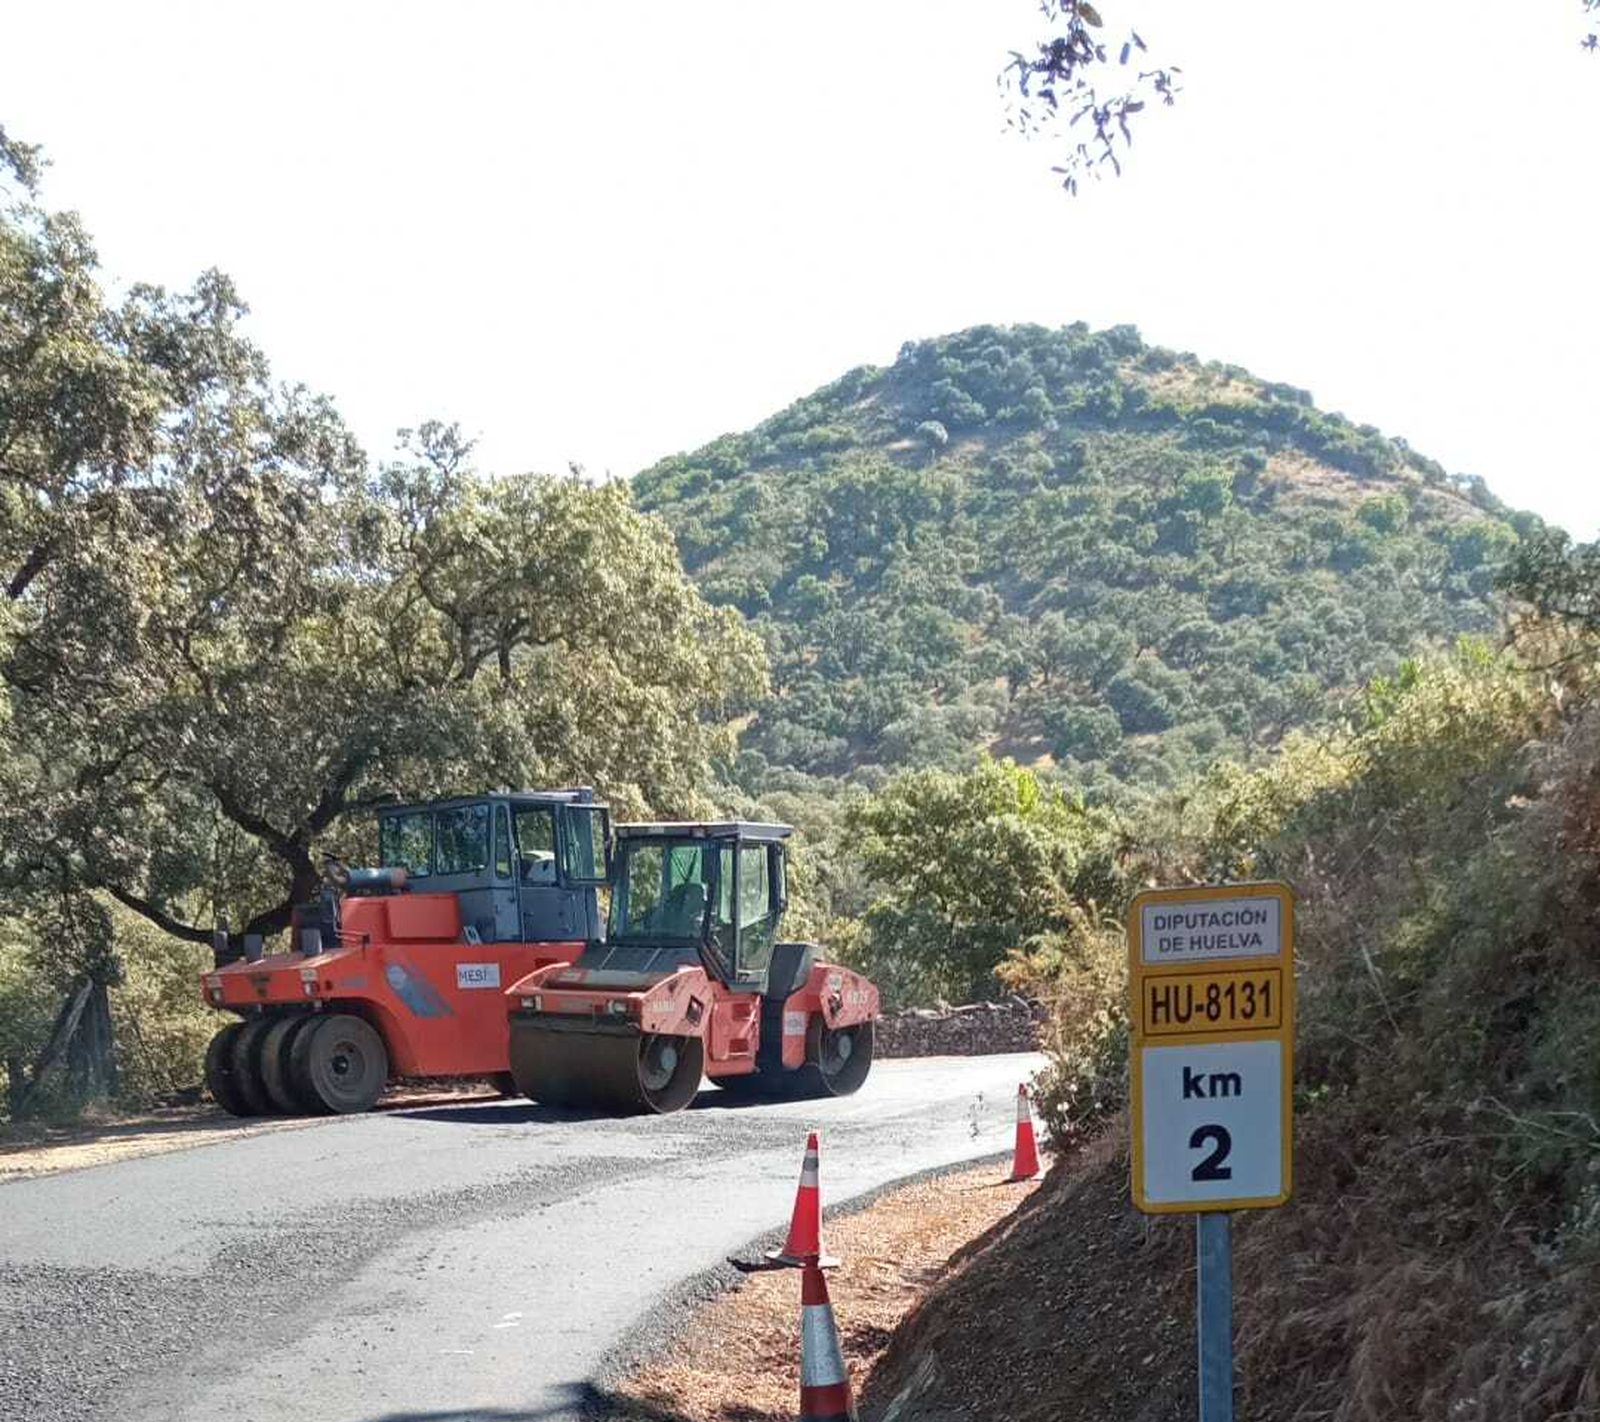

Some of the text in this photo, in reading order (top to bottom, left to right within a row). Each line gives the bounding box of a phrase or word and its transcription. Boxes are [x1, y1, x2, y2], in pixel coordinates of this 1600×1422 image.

[1154, 908, 1267, 931] DIPUTACIÓN
[1159, 932, 1263, 952] DE HUELVA
[1150, 979, 1272, 1024] HU-8131
[1182, 1066, 1242, 1099] km
[1189, 1124, 1232, 1181] 2
